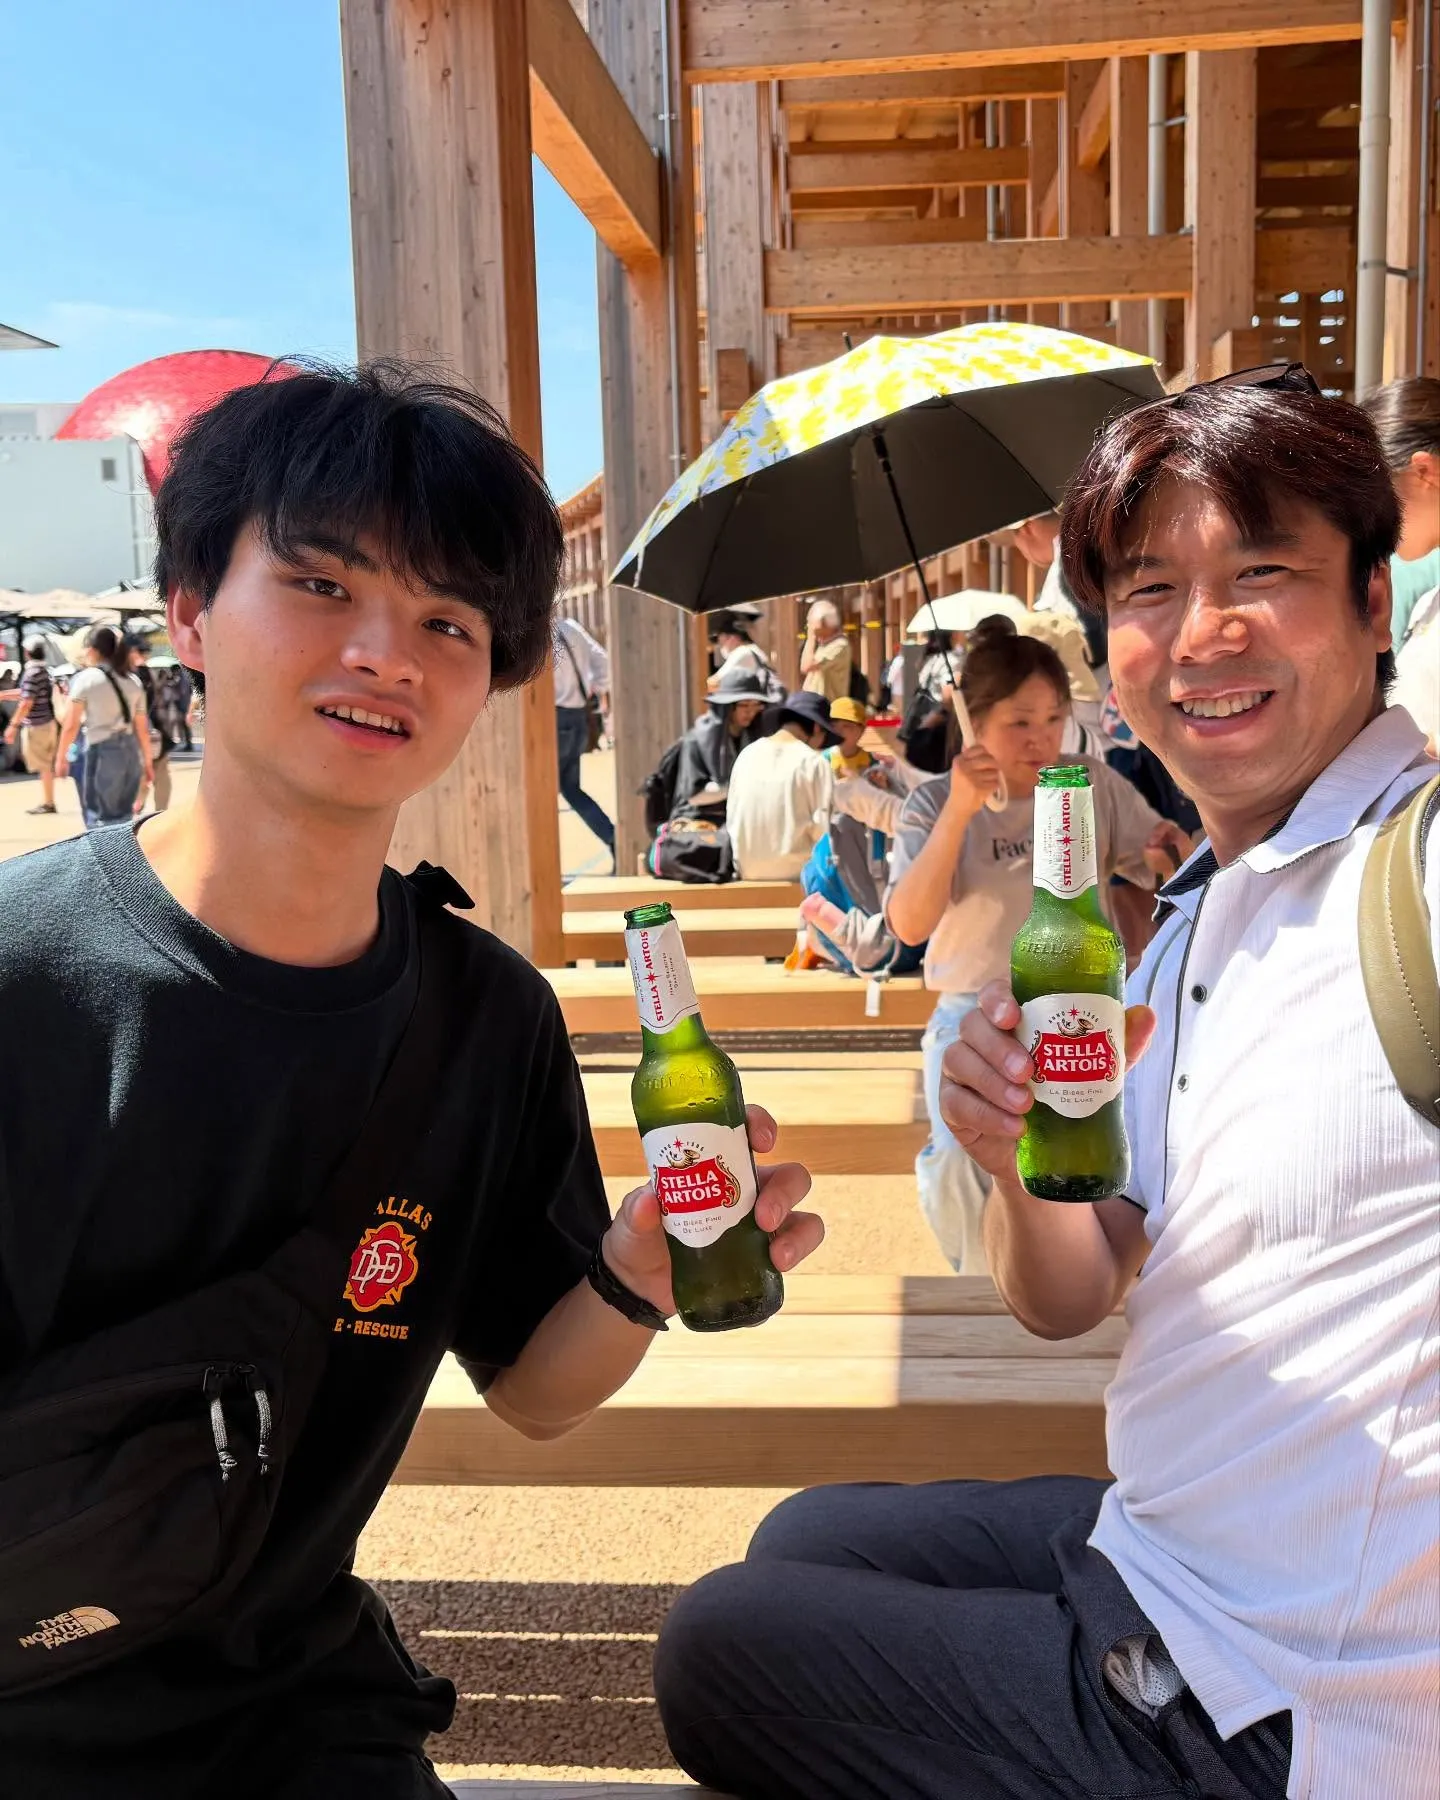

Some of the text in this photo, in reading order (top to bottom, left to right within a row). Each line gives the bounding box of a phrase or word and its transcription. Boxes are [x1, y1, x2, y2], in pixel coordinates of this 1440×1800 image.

[1062, 792, 1072, 886] STELLA ARTOIS
[640, 931, 664, 1022] STELLA ARTOIS
[1043, 1043, 1106, 1057] STELLA
[1043, 1057, 1107, 1072] ARTOIS
[661, 1170, 718, 1190] STELLA
[664, 1184, 722, 1204] ARTOIS
[375, 1196, 433, 1231] ALLAS
[353, 1320, 410, 1340] RESCUE
[35, 1612, 73, 1630] THE
[18, 1619, 81, 1648] NORTH
[42, 1627, 89, 1650] FACE
